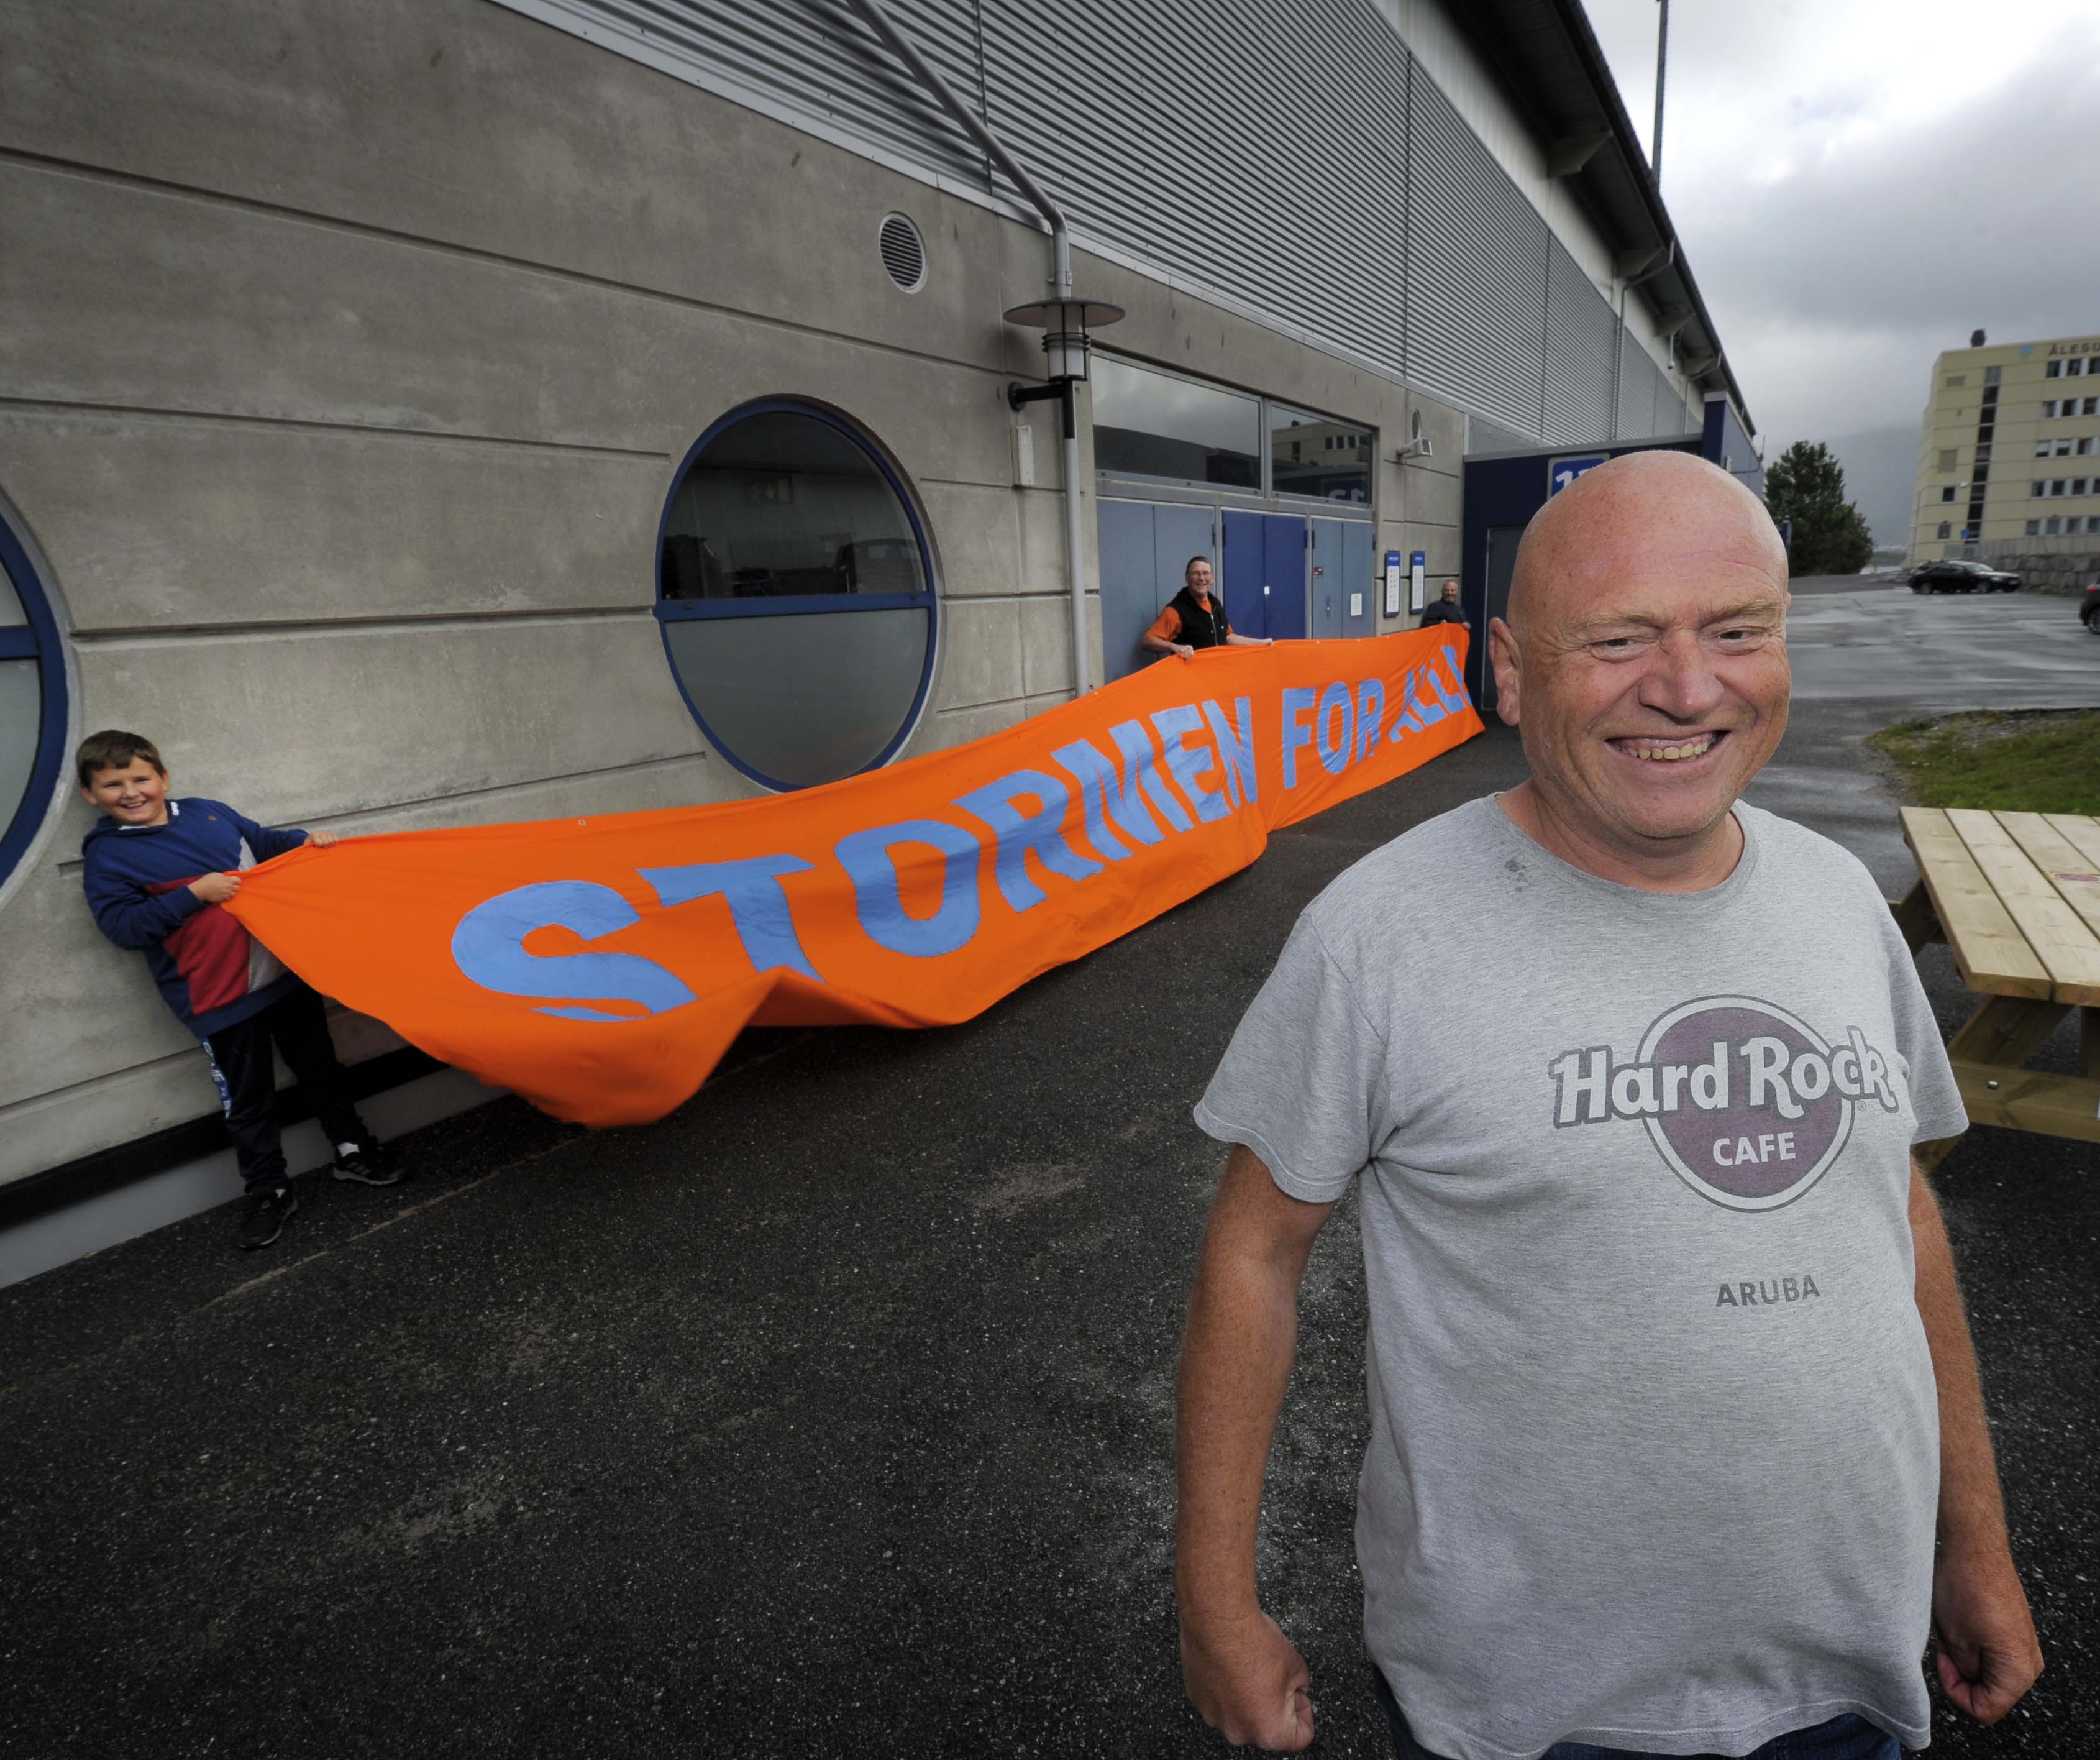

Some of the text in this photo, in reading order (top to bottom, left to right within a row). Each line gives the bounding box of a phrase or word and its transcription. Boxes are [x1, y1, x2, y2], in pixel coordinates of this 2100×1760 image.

[452, 696, 1258, 1022] STORMEN
[1282, 678, 1385, 789] FOR
[1549, 1025, 1899, 1129] Hard Rock
[1712, 1131, 1796, 1166] CAFE
[1715, 1274, 1821, 1308] ARUBA
